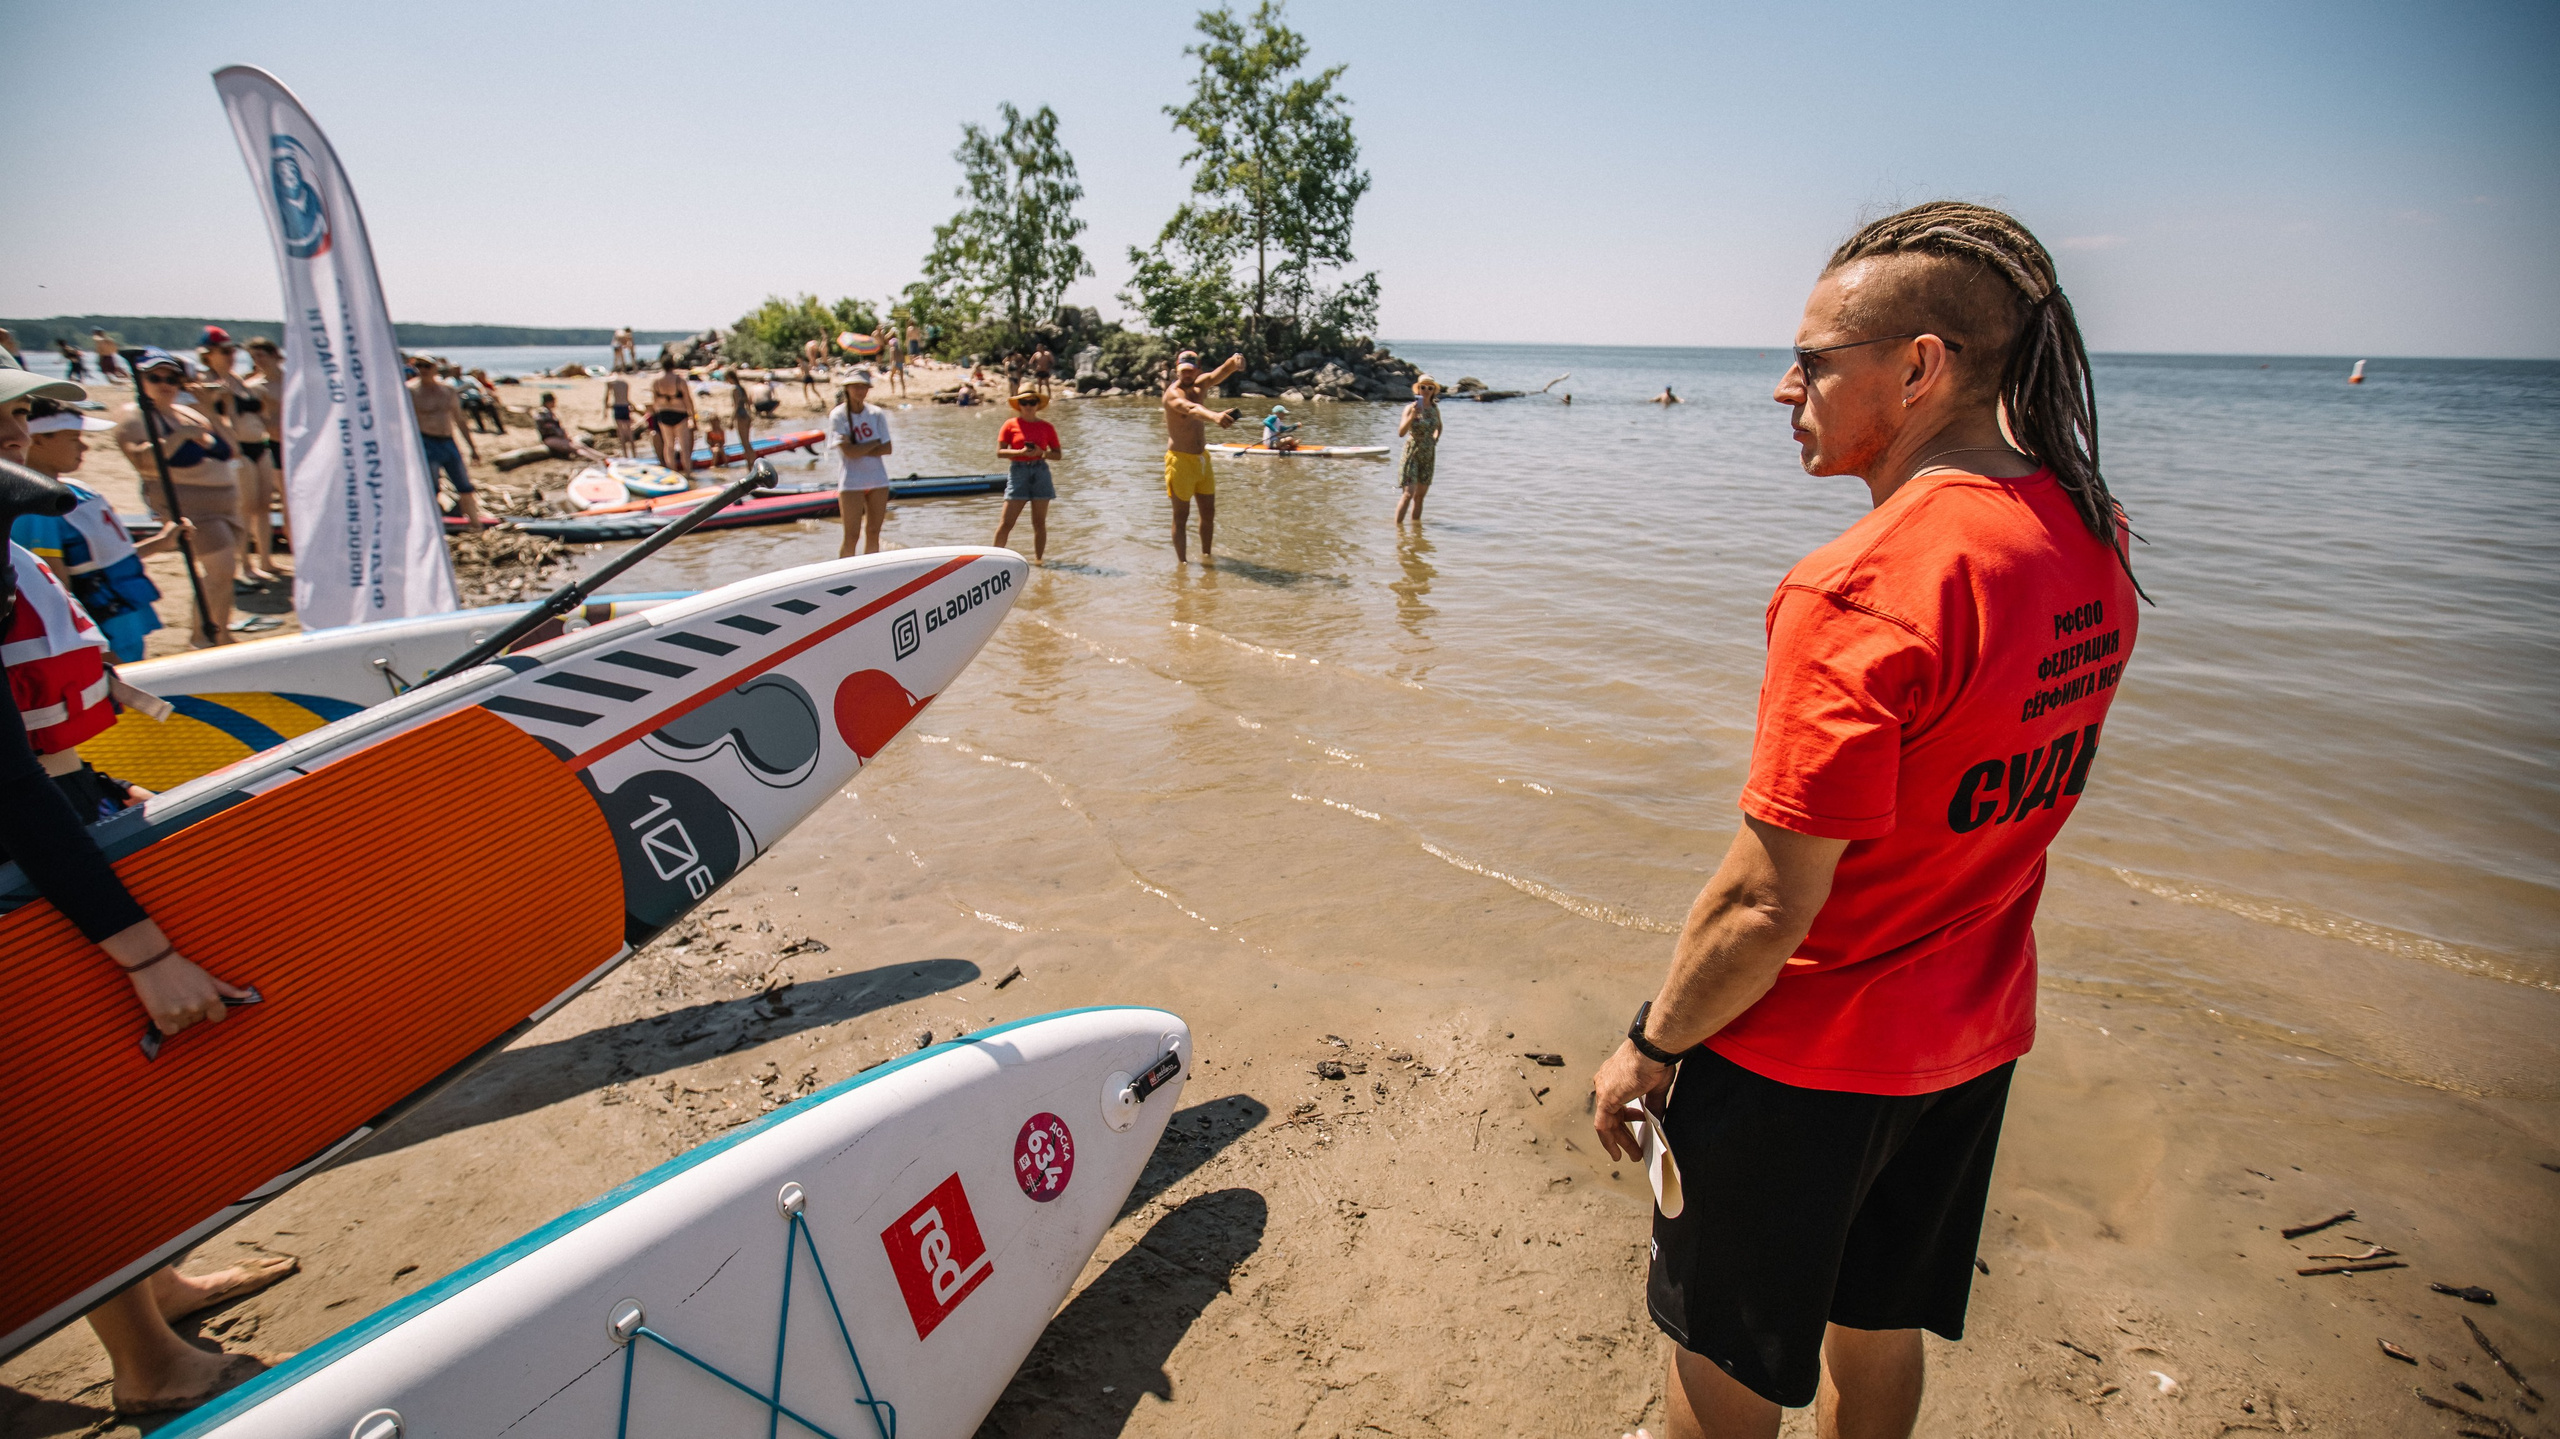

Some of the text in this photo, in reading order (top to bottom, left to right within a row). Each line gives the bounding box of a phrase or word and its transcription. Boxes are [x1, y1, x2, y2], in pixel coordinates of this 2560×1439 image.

[854, 422, 873, 441] 16
[2053, 600, 2103, 641] РФСОО
[2037, 628, 2120, 682] ФЕДЕРАЦИЯ
[1027, 1129, 1063, 1191] 634
[1049, 1121, 1071, 1162] ДОСКА
[909, 1205, 992, 1307] red
